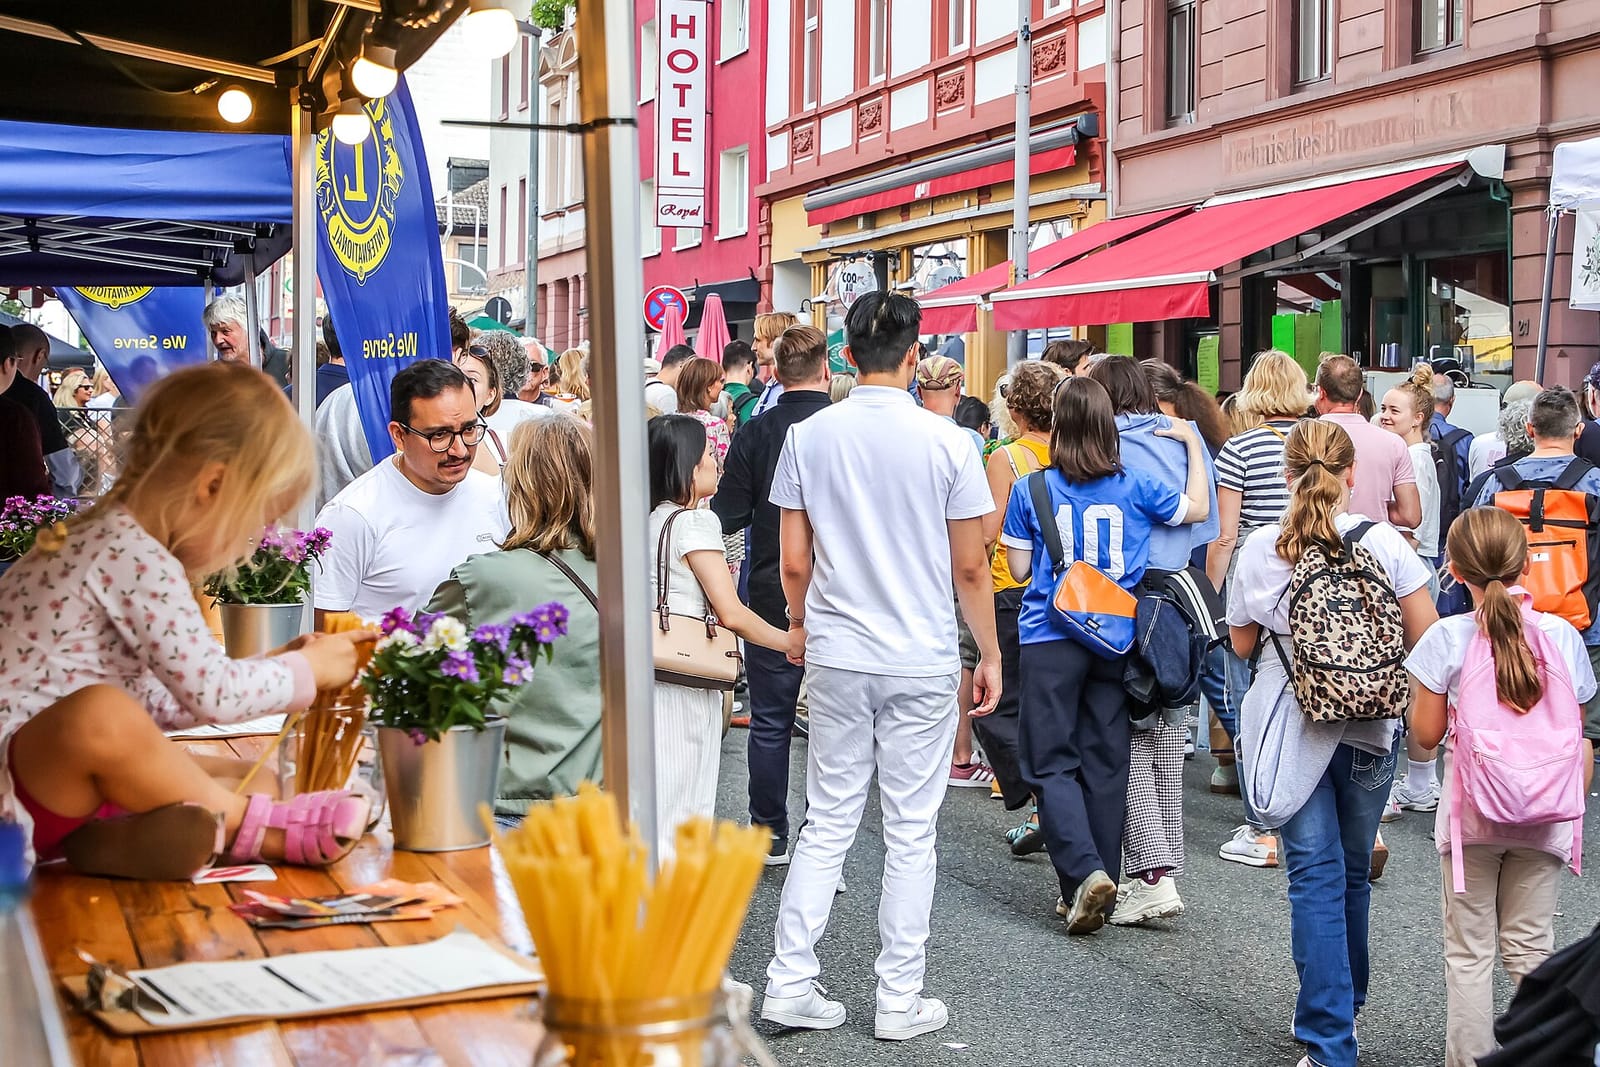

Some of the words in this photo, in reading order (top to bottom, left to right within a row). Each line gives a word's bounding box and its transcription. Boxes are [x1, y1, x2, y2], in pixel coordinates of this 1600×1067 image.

[666, 14, 699, 177] HOTEL
[659, 203, 702, 220] Royal
[841, 272, 858, 284] COQ
[845, 283, 854, 292] AU
[1054, 504, 1126, 580] 10
